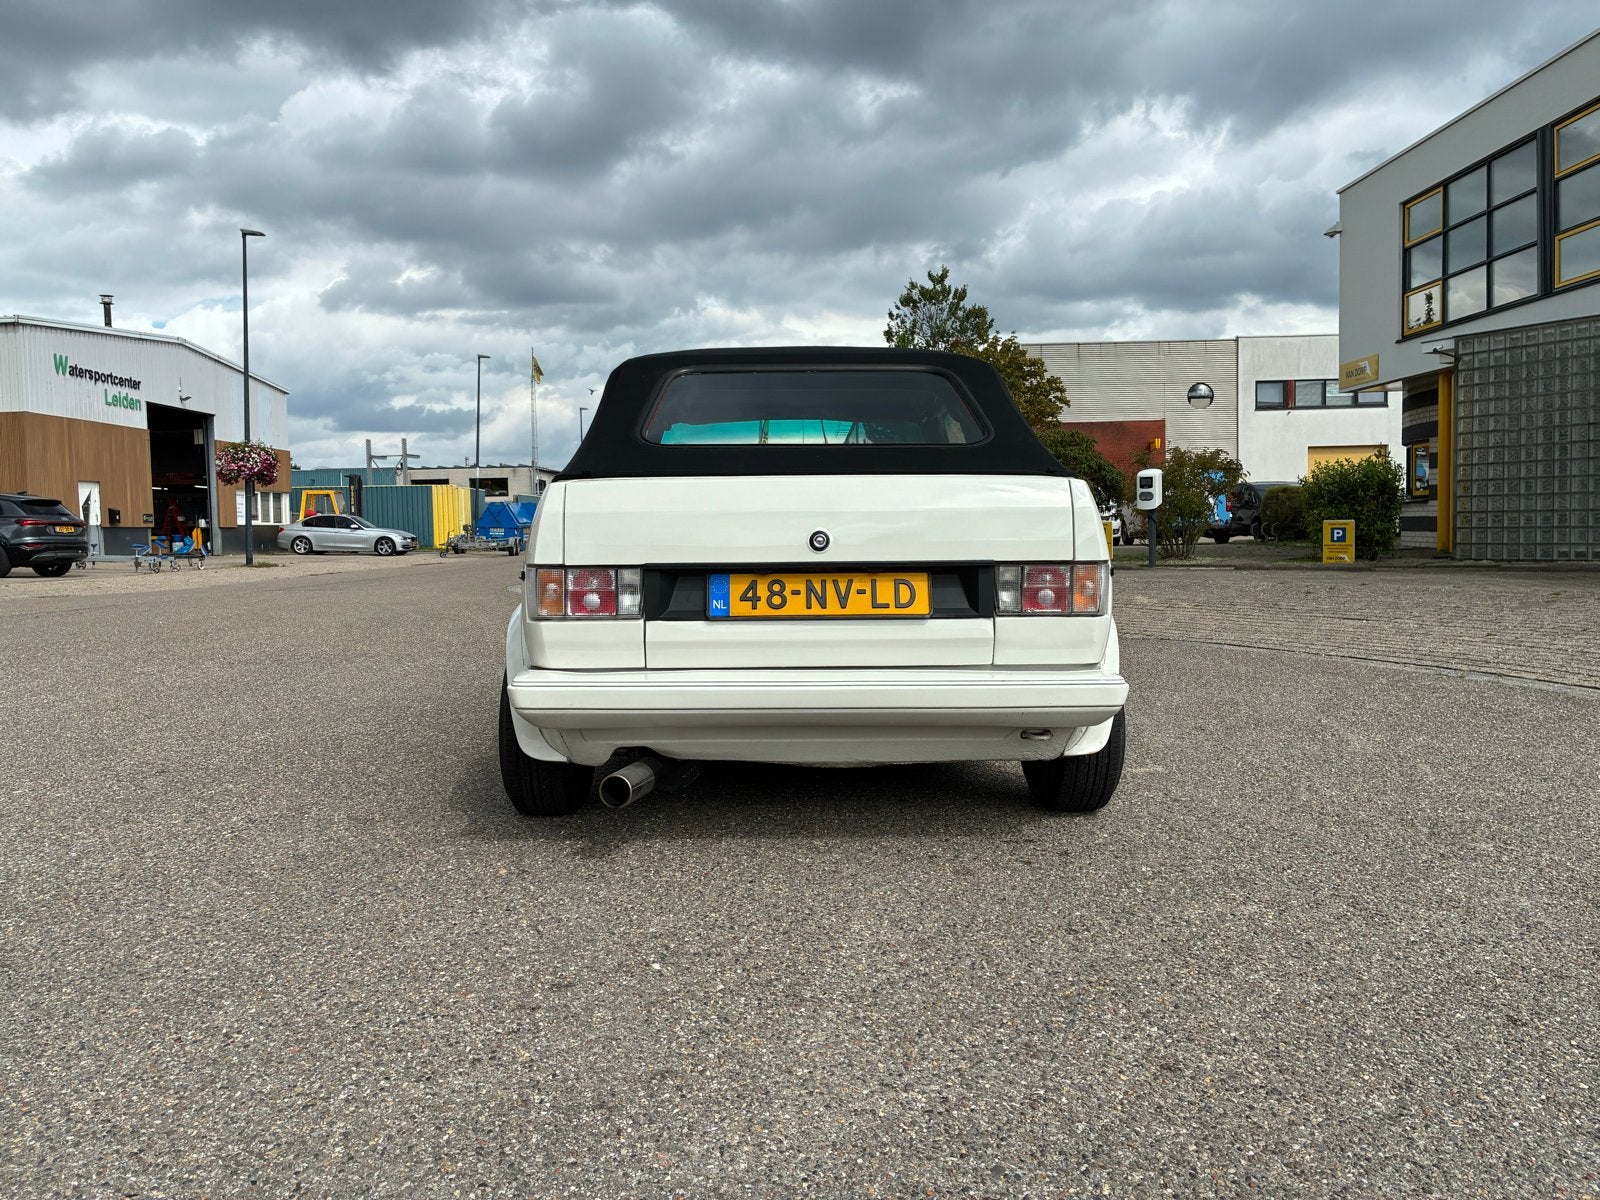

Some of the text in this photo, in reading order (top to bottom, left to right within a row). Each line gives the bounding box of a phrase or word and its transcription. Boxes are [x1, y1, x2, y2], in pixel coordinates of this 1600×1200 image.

[53, 353, 141, 390] Watersportcenter
[104, 388, 141, 411] Leiden
[1333, 529, 1343, 541] P
[712, 599, 727, 610] NL
[739, 578, 917, 610] 48-NV-LD
